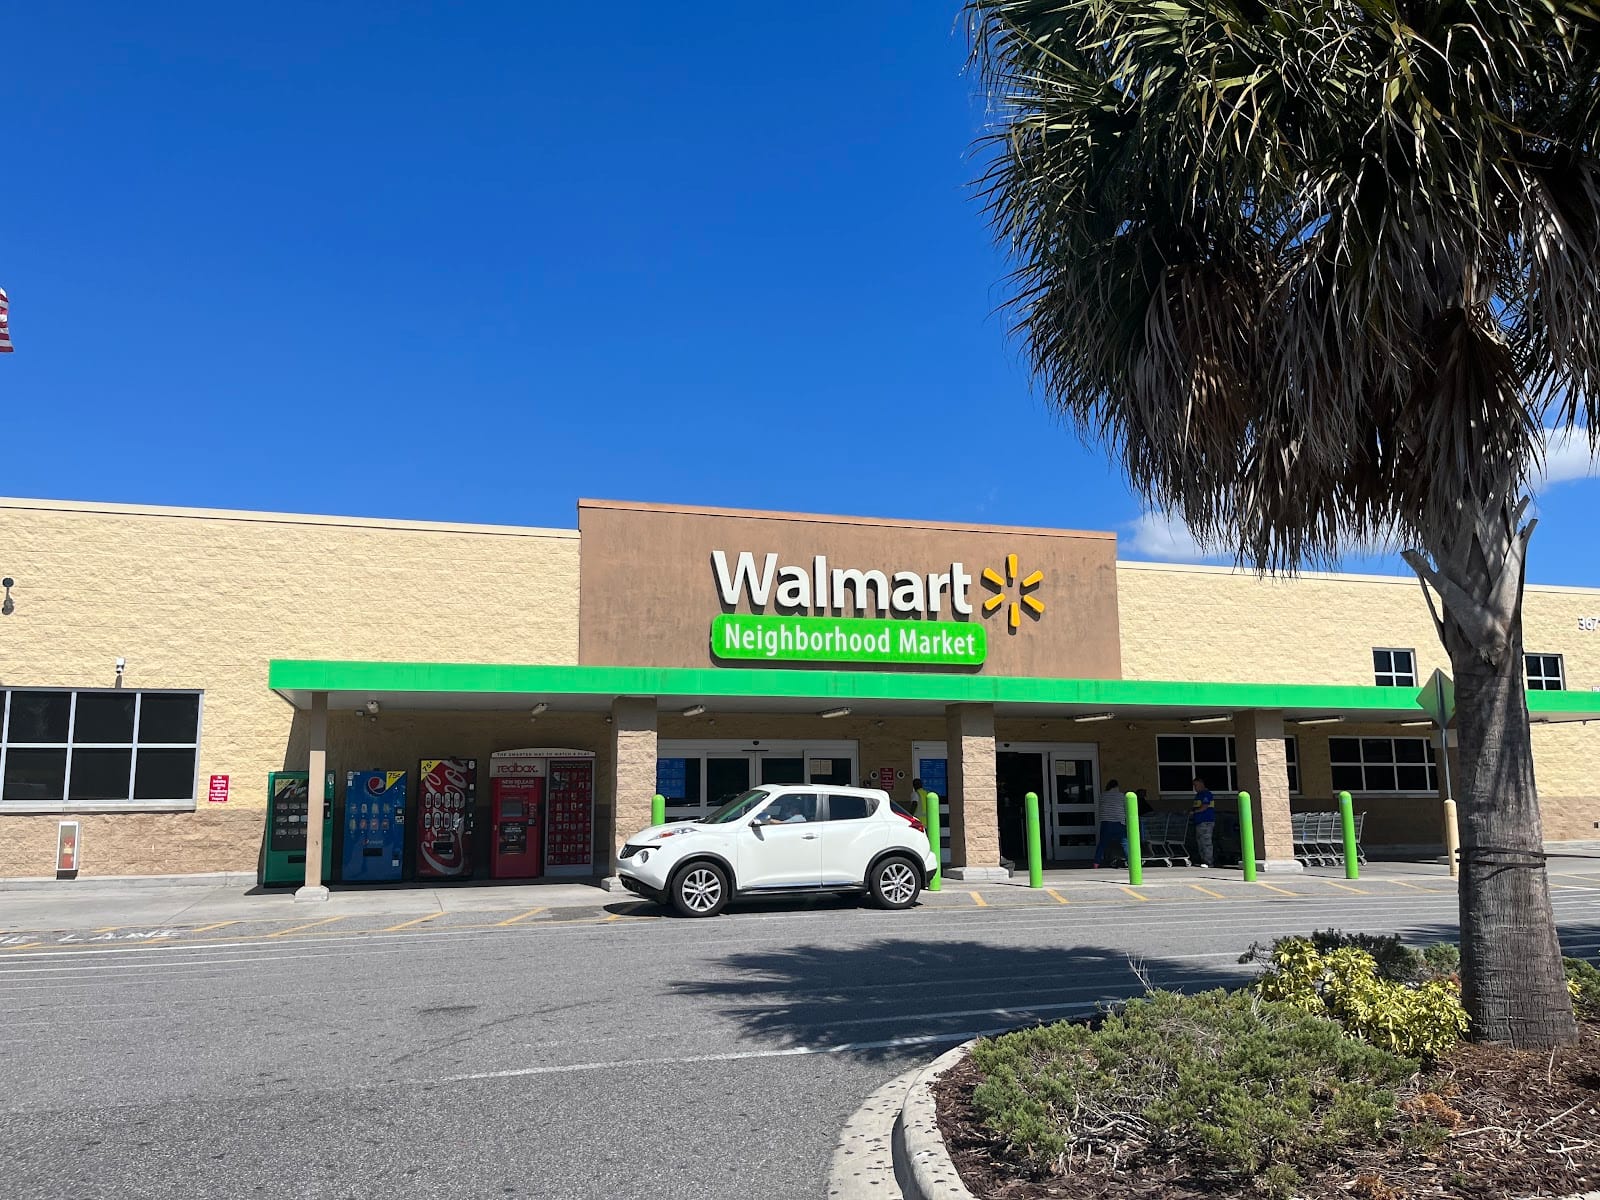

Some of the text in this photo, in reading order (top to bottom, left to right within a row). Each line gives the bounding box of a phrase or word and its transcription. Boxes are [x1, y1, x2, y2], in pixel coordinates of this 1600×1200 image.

[712, 550, 973, 615] Walmart
[1577, 615, 1600, 630] 367
[724, 623, 976, 656] Neighborhood Market
